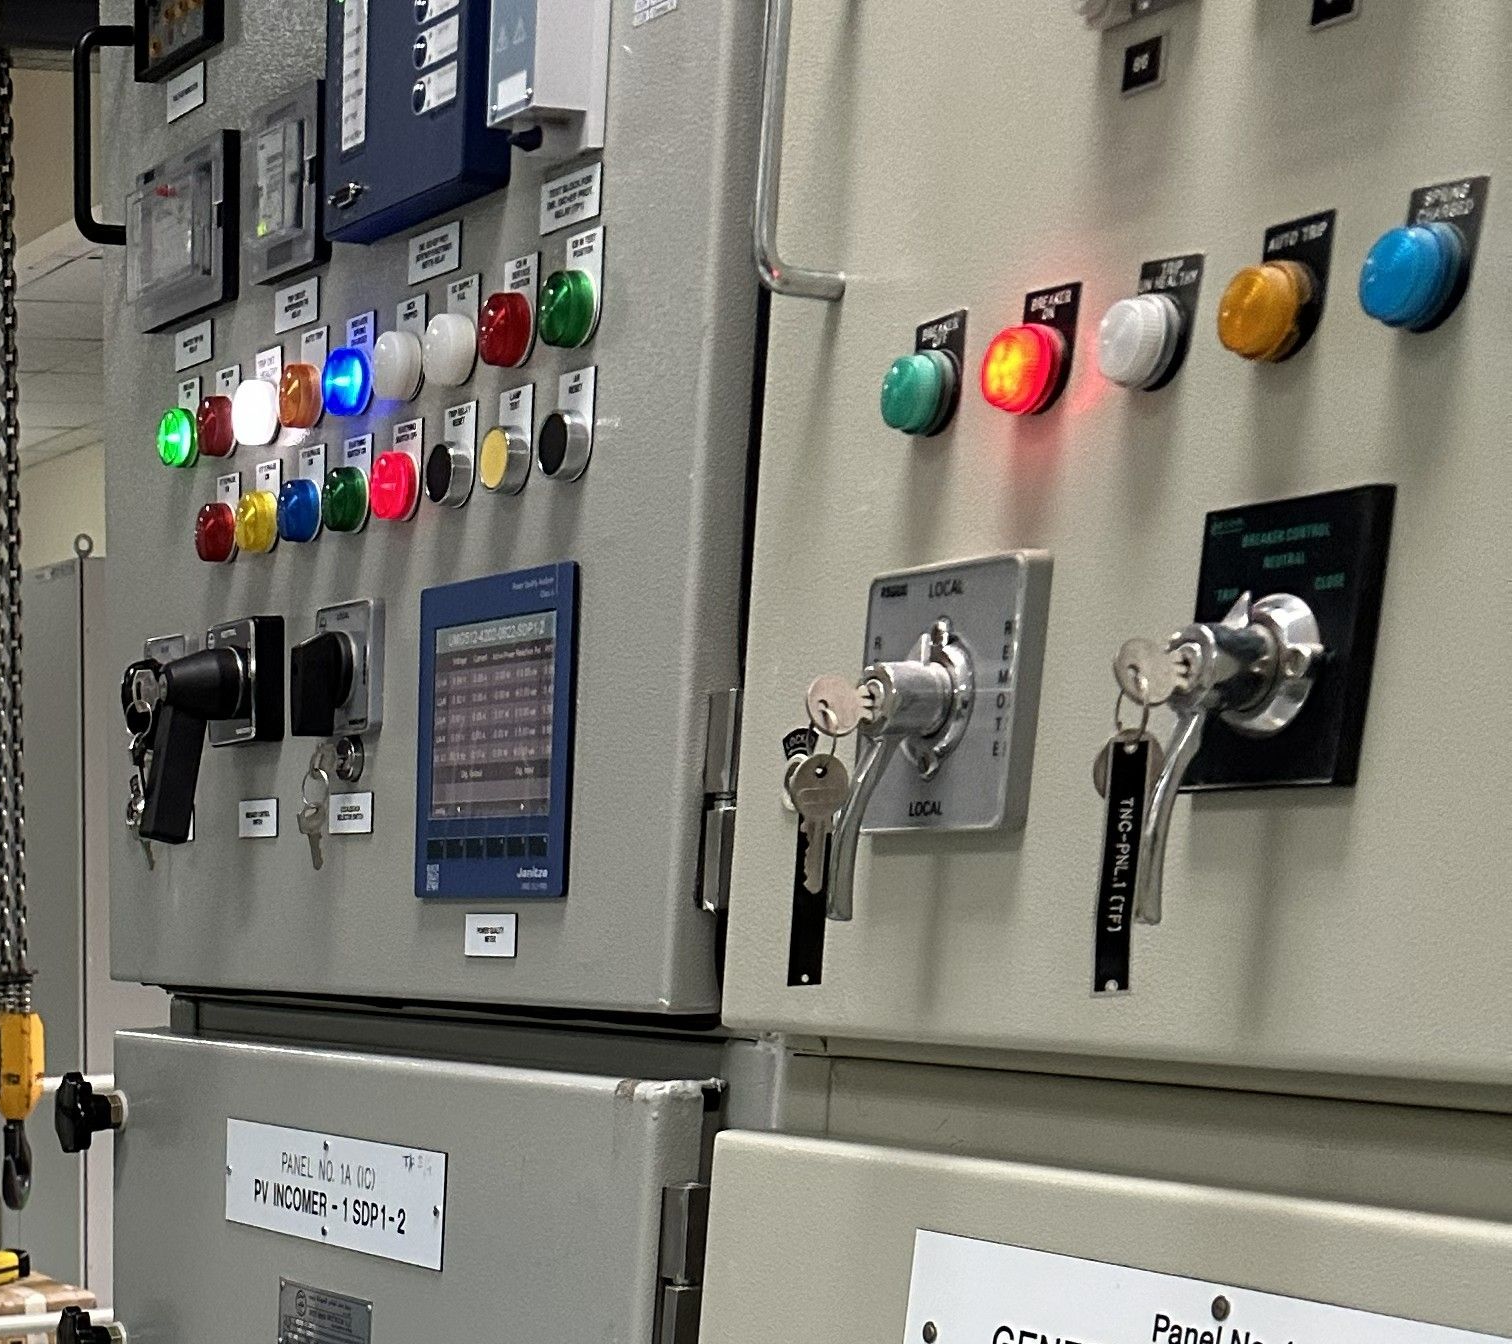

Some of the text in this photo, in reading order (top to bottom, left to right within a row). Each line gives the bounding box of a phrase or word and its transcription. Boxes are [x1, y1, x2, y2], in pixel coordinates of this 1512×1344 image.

[1267, 221, 1328, 253] AUTO TRIP
[928, 579, 964, 599] LOCAL
[992, 620, 1013, 757] REMOTE
[909, 801, 944, 817] LOCAL
[1106, 897, 1126, 932] (TF)
[281, 1152, 314, 1179] PANEL
[319, 1160, 335, 1183] NO.
[340, 1164, 351, 1186] 1A
[357, 1164, 376, 1192] (IC)
[254, 1179, 269, 1203] PV
[273, 1183, 327, 1218] INCOMER
[342, 1197, 348, 1223] 1
